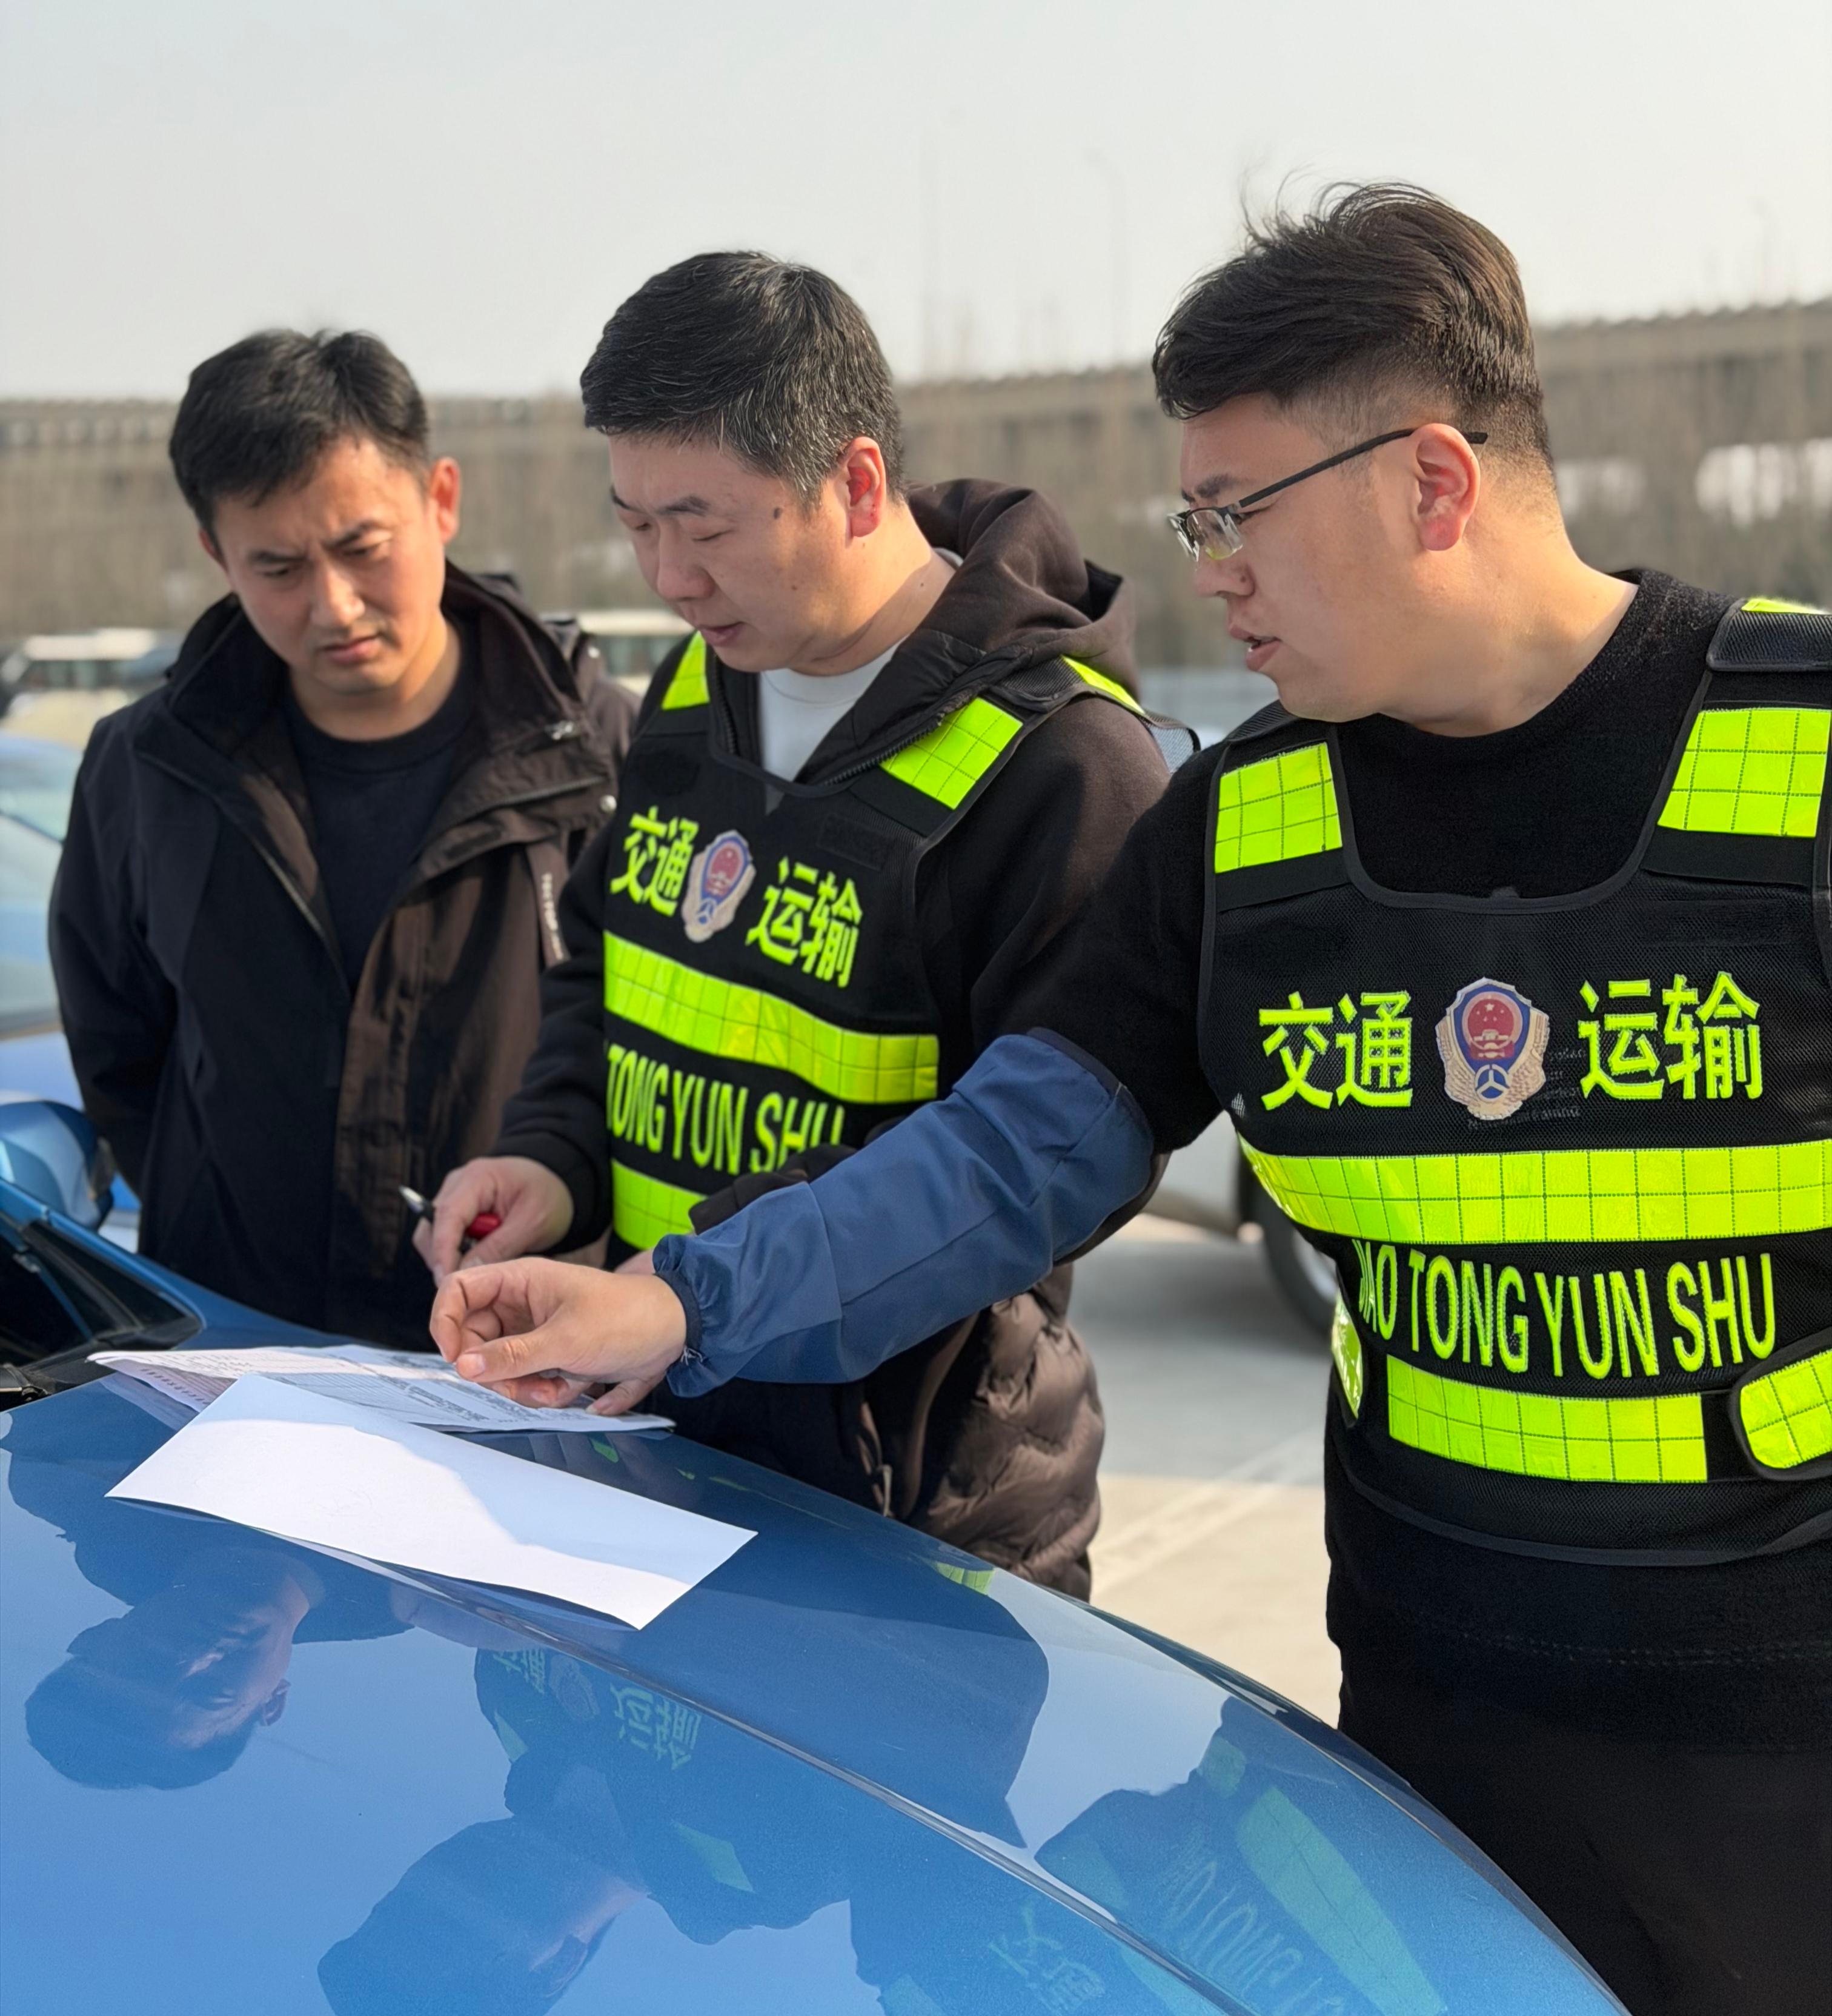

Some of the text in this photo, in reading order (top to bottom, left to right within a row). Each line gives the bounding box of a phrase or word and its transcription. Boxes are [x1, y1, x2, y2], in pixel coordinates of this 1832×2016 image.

[609, 806, 700, 917] 交通
[745, 855, 864, 989] 运输
[606, 1043, 669, 1153] TONG
[672, 1070, 749, 1176] YUN
[1258, 971, 1764, 1112] 交通 运输
[1408, 1248, 1530, 1374] TONG
[1533, 1268, 1660, 1381] YUN
[1665, 1253, 1777, 1373] SHU
